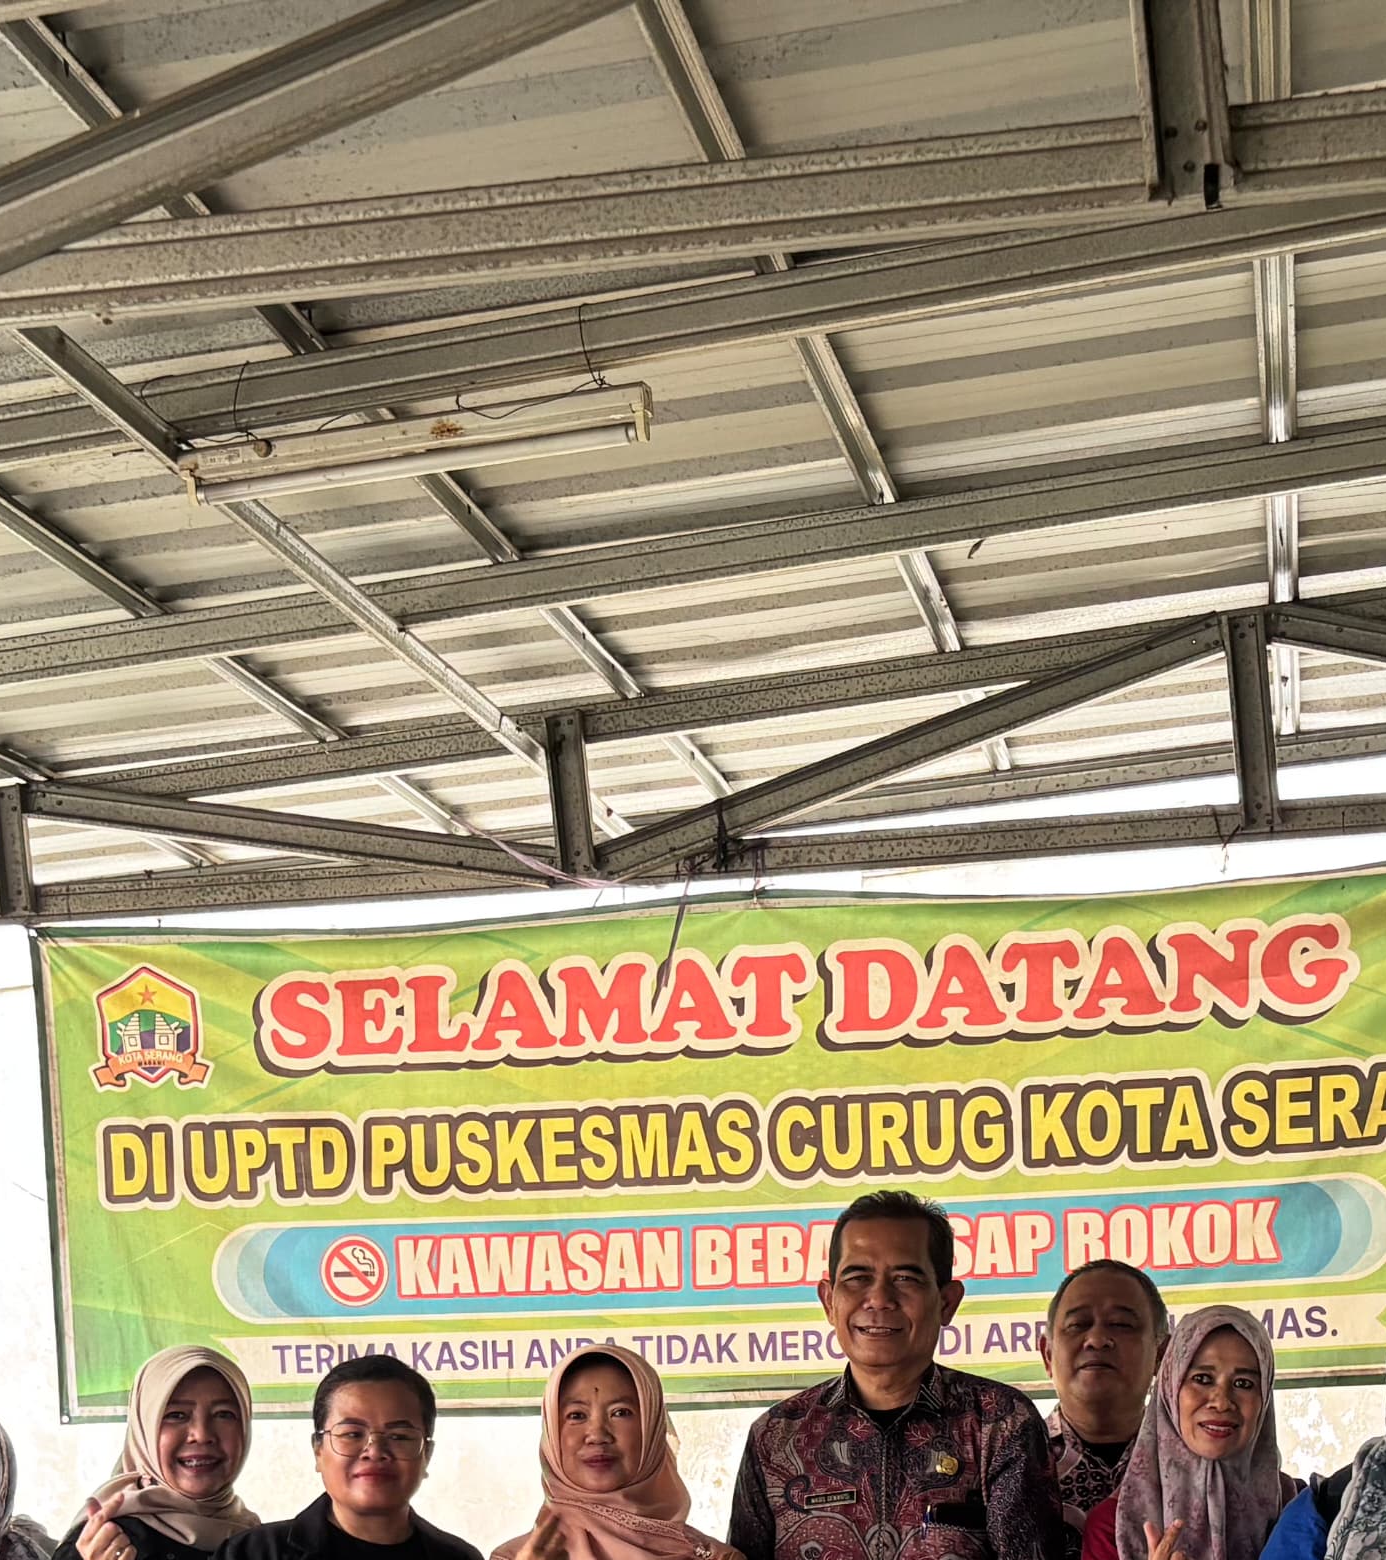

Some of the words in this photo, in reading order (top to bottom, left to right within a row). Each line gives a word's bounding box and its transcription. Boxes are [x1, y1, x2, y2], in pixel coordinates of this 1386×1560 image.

[266, 950, 810, 1060] SELAMAT
[834, 920, 1352, 1033] DATANG
[118, 1050, 143, 1065] KOTA
[144, 1048, 184, 1064] SERANG
[107, 1130, 168, 1198] DI
[189, 1126, 350, 1194] UPTD
[369, 1108, 754, 1188] PUSKESMAS
[775, 1093, 1008, 1174] CURUG
[1029, 1084, 1211, 1162] KOTA
[396, 1227, 682, 1300] KAWASAN
[692, 1219, 836, 1292] BEBA
[949, 1211, 1055, 1280] SAP
[1064, 1197, 1282, 1275] ROKOK
[411, 1339, 515, 1372] KASIH
[524, 1336, 617, 1369] AN
[631, 1332, 739, 1367] TIDAK
[938, 1323, 972, 1356] DI
[983, 1320, 1048, 1355] AR
